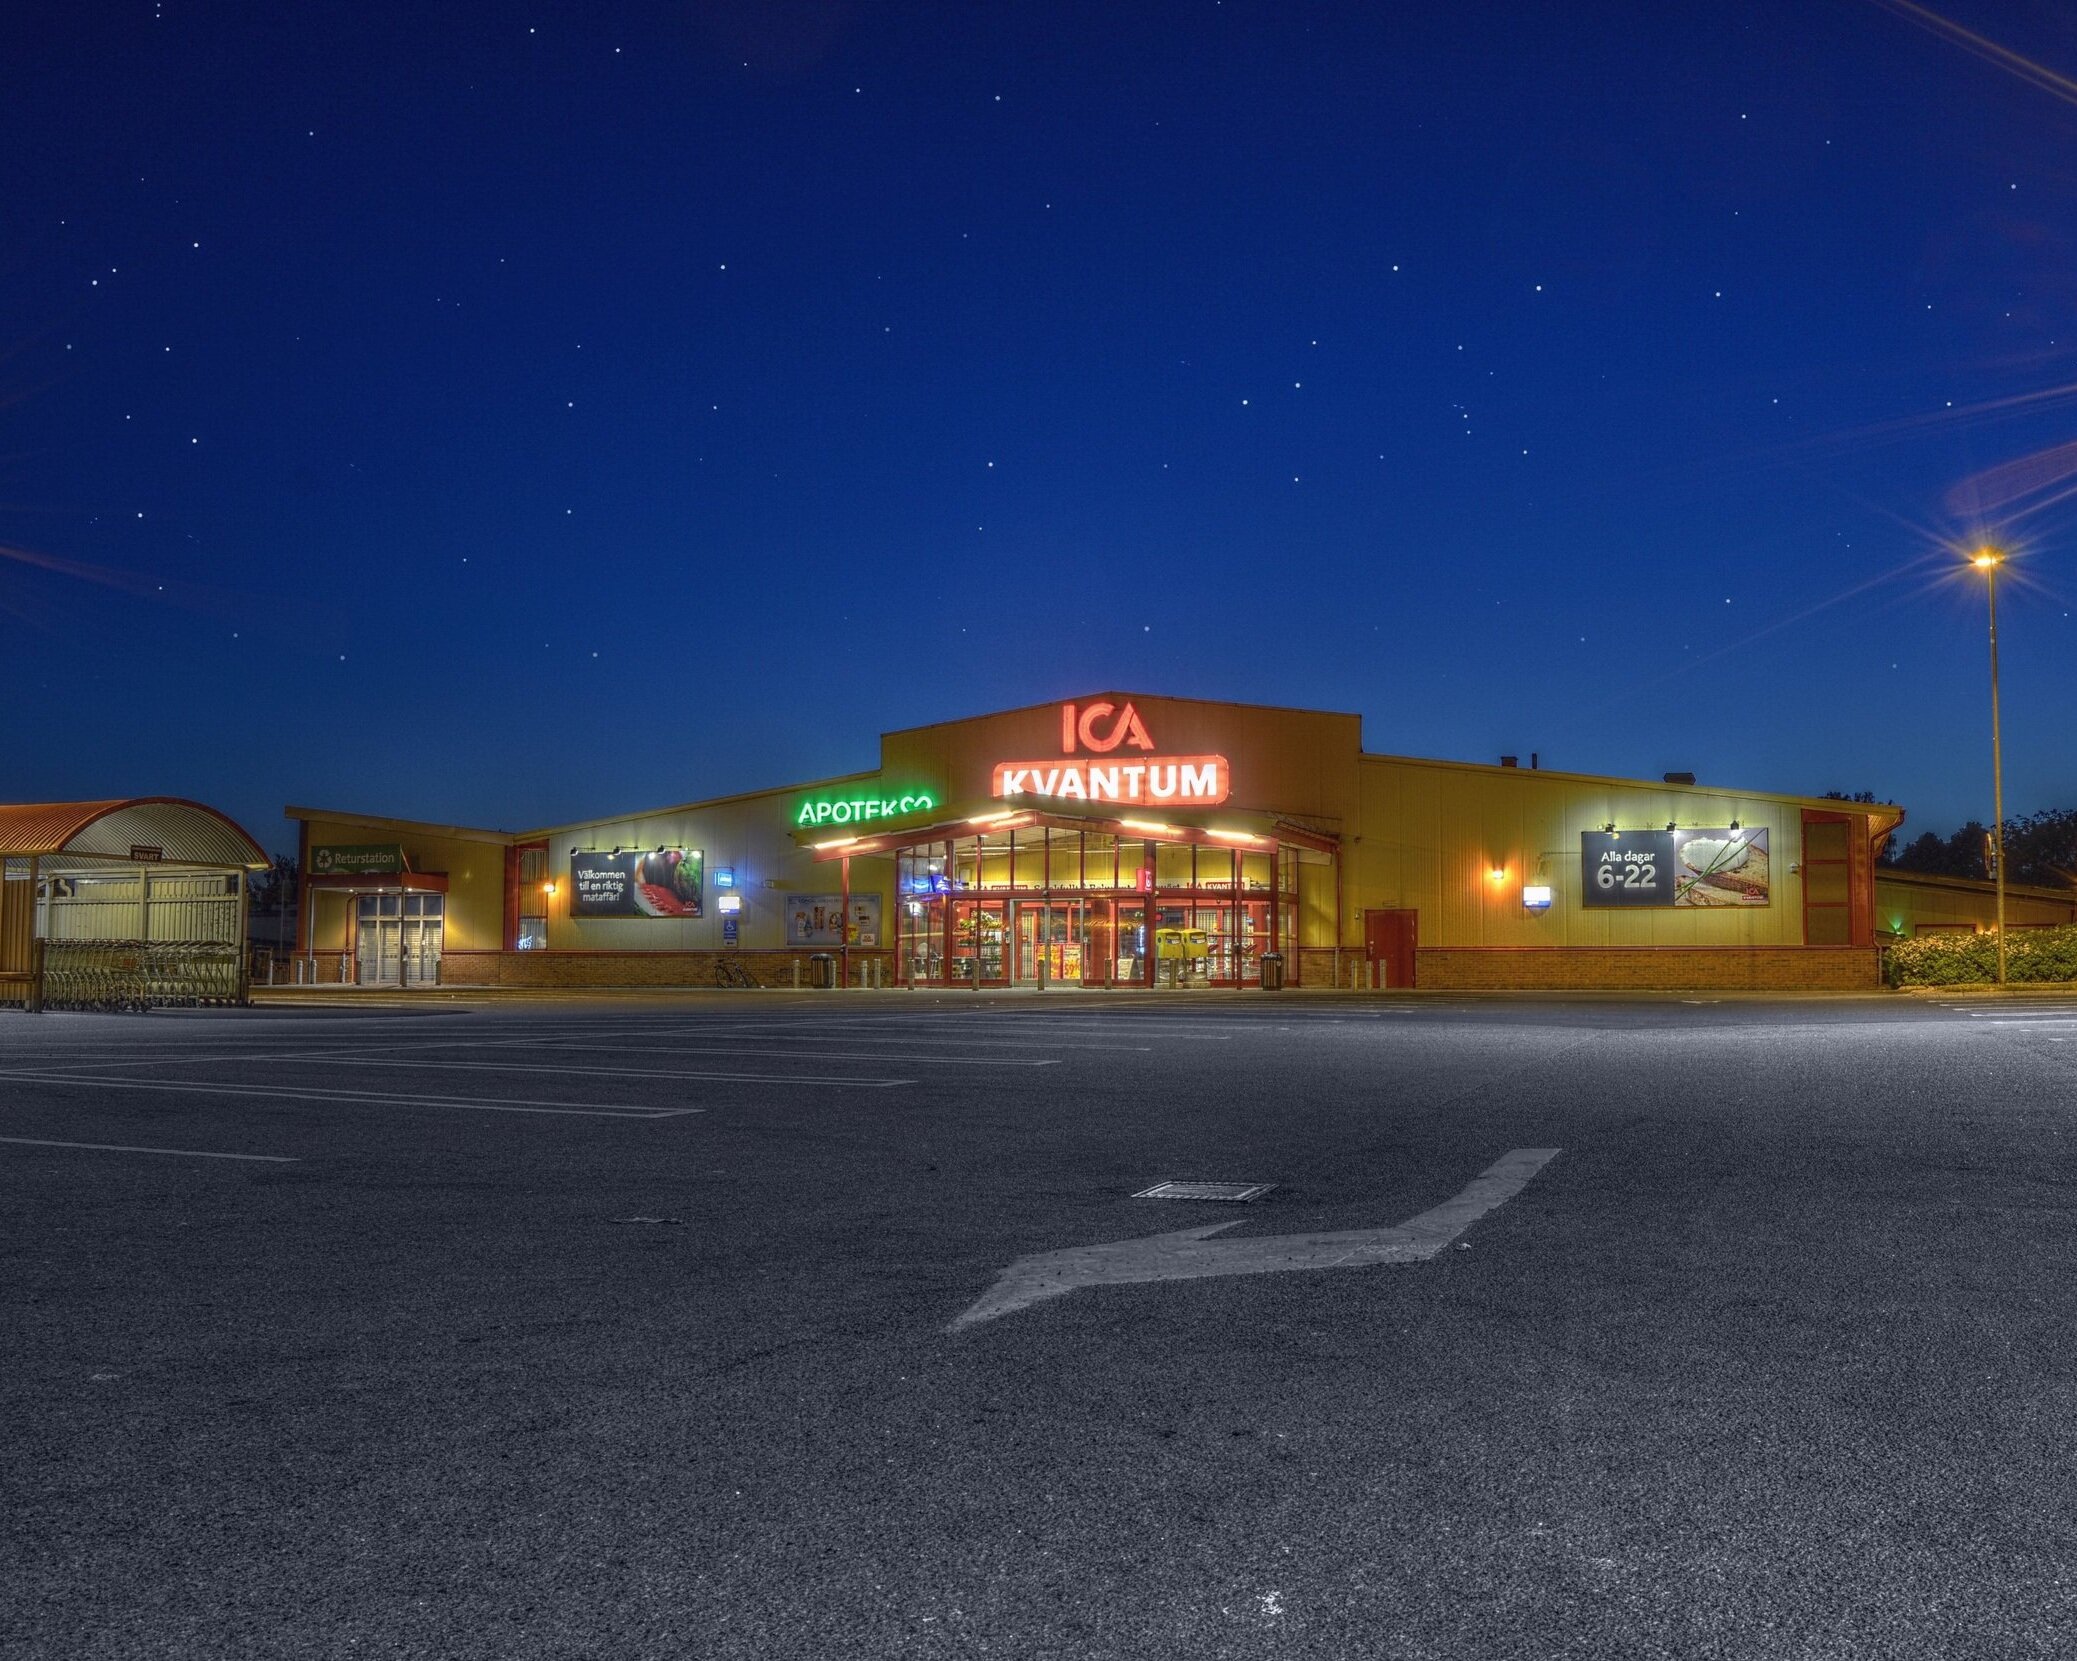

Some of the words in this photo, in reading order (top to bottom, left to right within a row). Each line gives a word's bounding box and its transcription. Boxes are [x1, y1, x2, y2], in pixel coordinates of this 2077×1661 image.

[1063, 701, 1155, 753] ICA
[1002, 764, 1218, 800] KVANTUM
[798, 800, 898, 824] APOTEK
[335, 852, 395, 864] Returstation
[1601, 851, 1622, 862] Alla
[1624, 850, 1656, 865] dagar
[577, 869, 626, 880] Välkommen
[1597, 864, 1657, 889] 6-22
[579, 882, 590, 891] till
[602, 881, 624, 893] riktig
[582, 891, 620, 902] mataffär!
